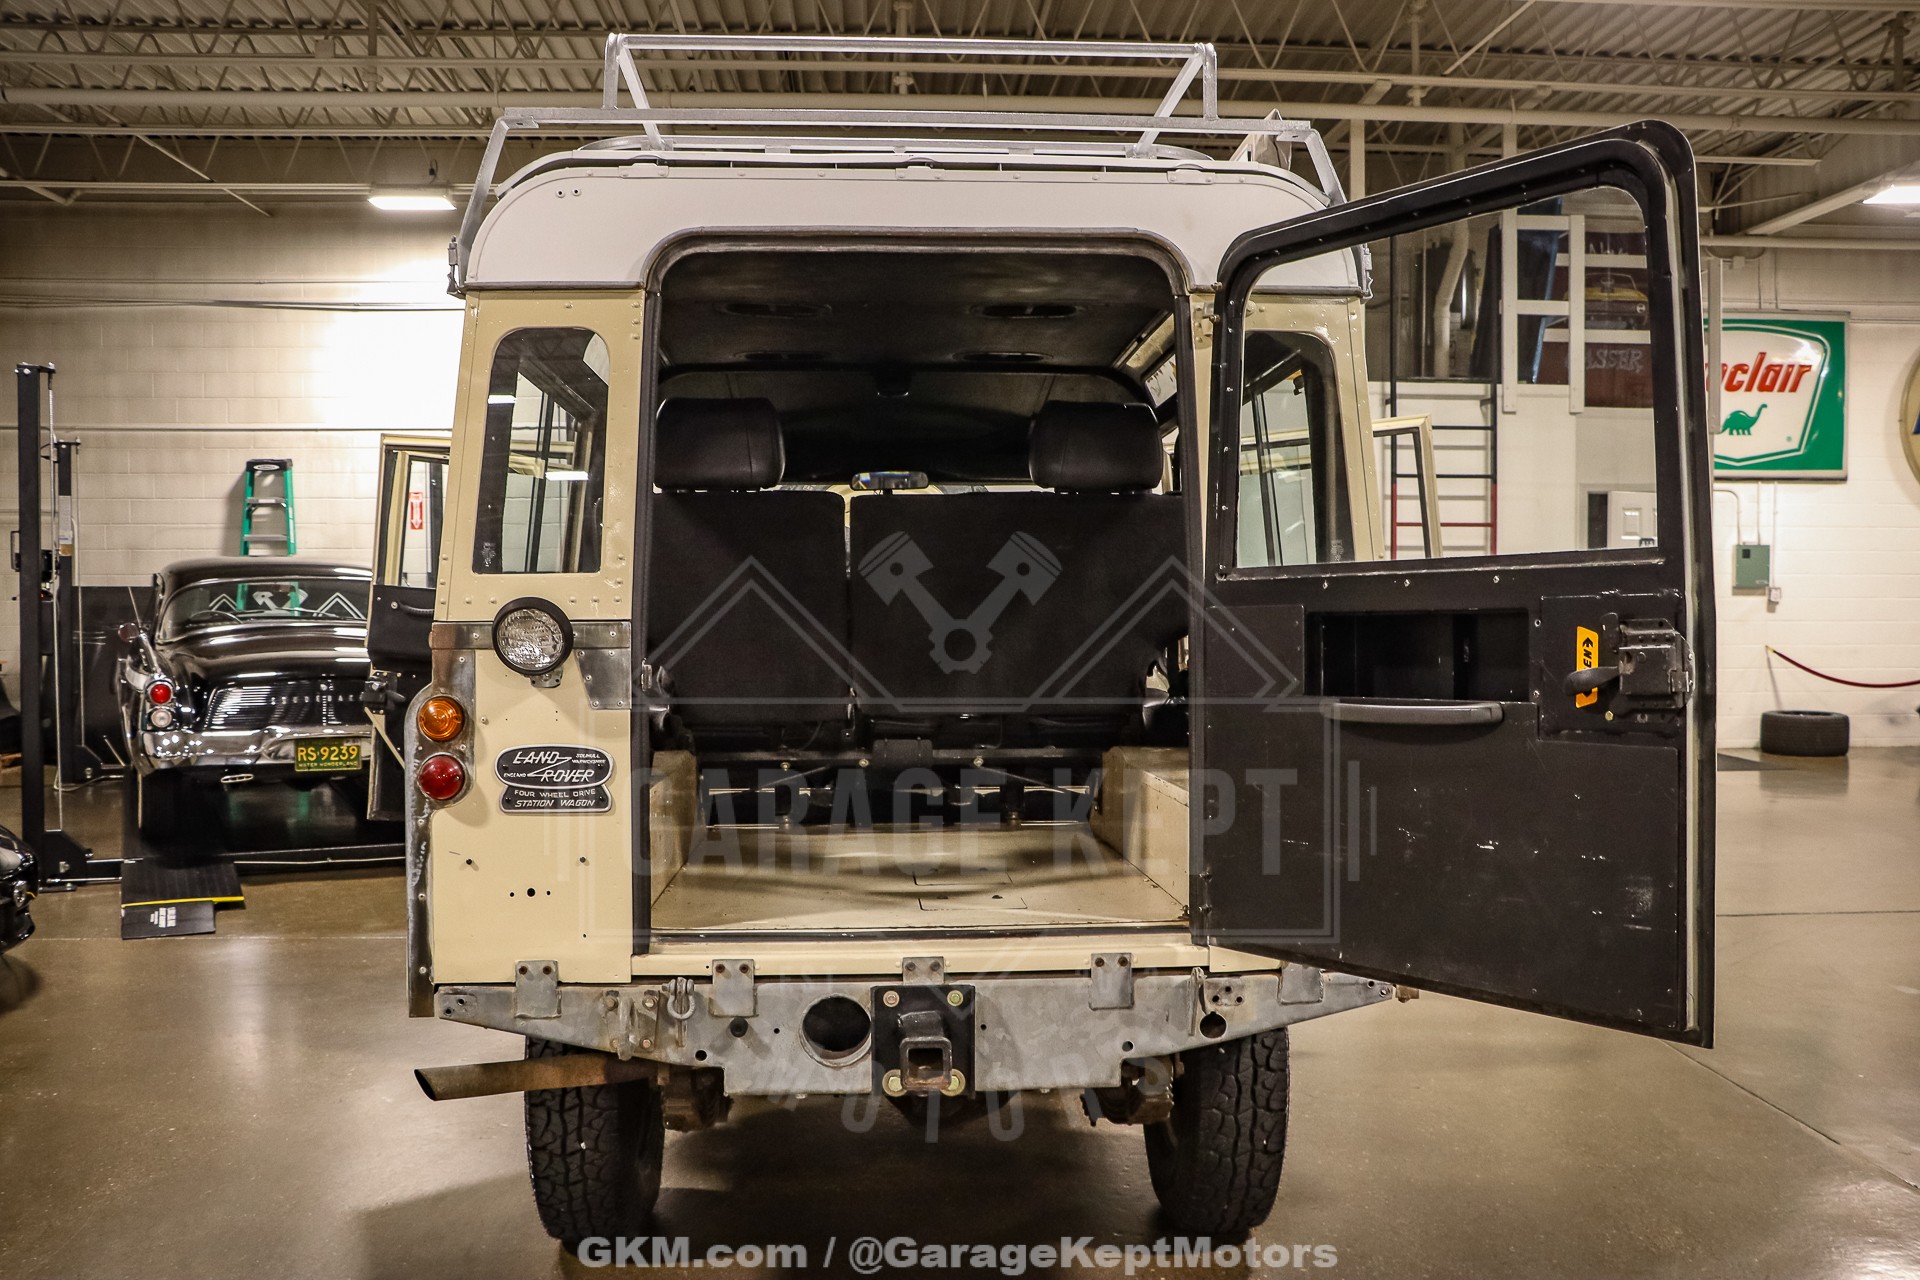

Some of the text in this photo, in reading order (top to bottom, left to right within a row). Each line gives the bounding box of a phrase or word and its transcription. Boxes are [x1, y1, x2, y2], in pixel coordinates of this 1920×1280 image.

[1705, 352, 1812, 393] clair
[1584, 649, 1592, 669] EN
[513, 751, 560, 765] LAND
[540, 769, 595, 783] ROVER
[514, 789, 535, 798] FOUR
[573, 788, 596, 798] DRIVE
[514, 799, 596, 808] STATION WAGON
